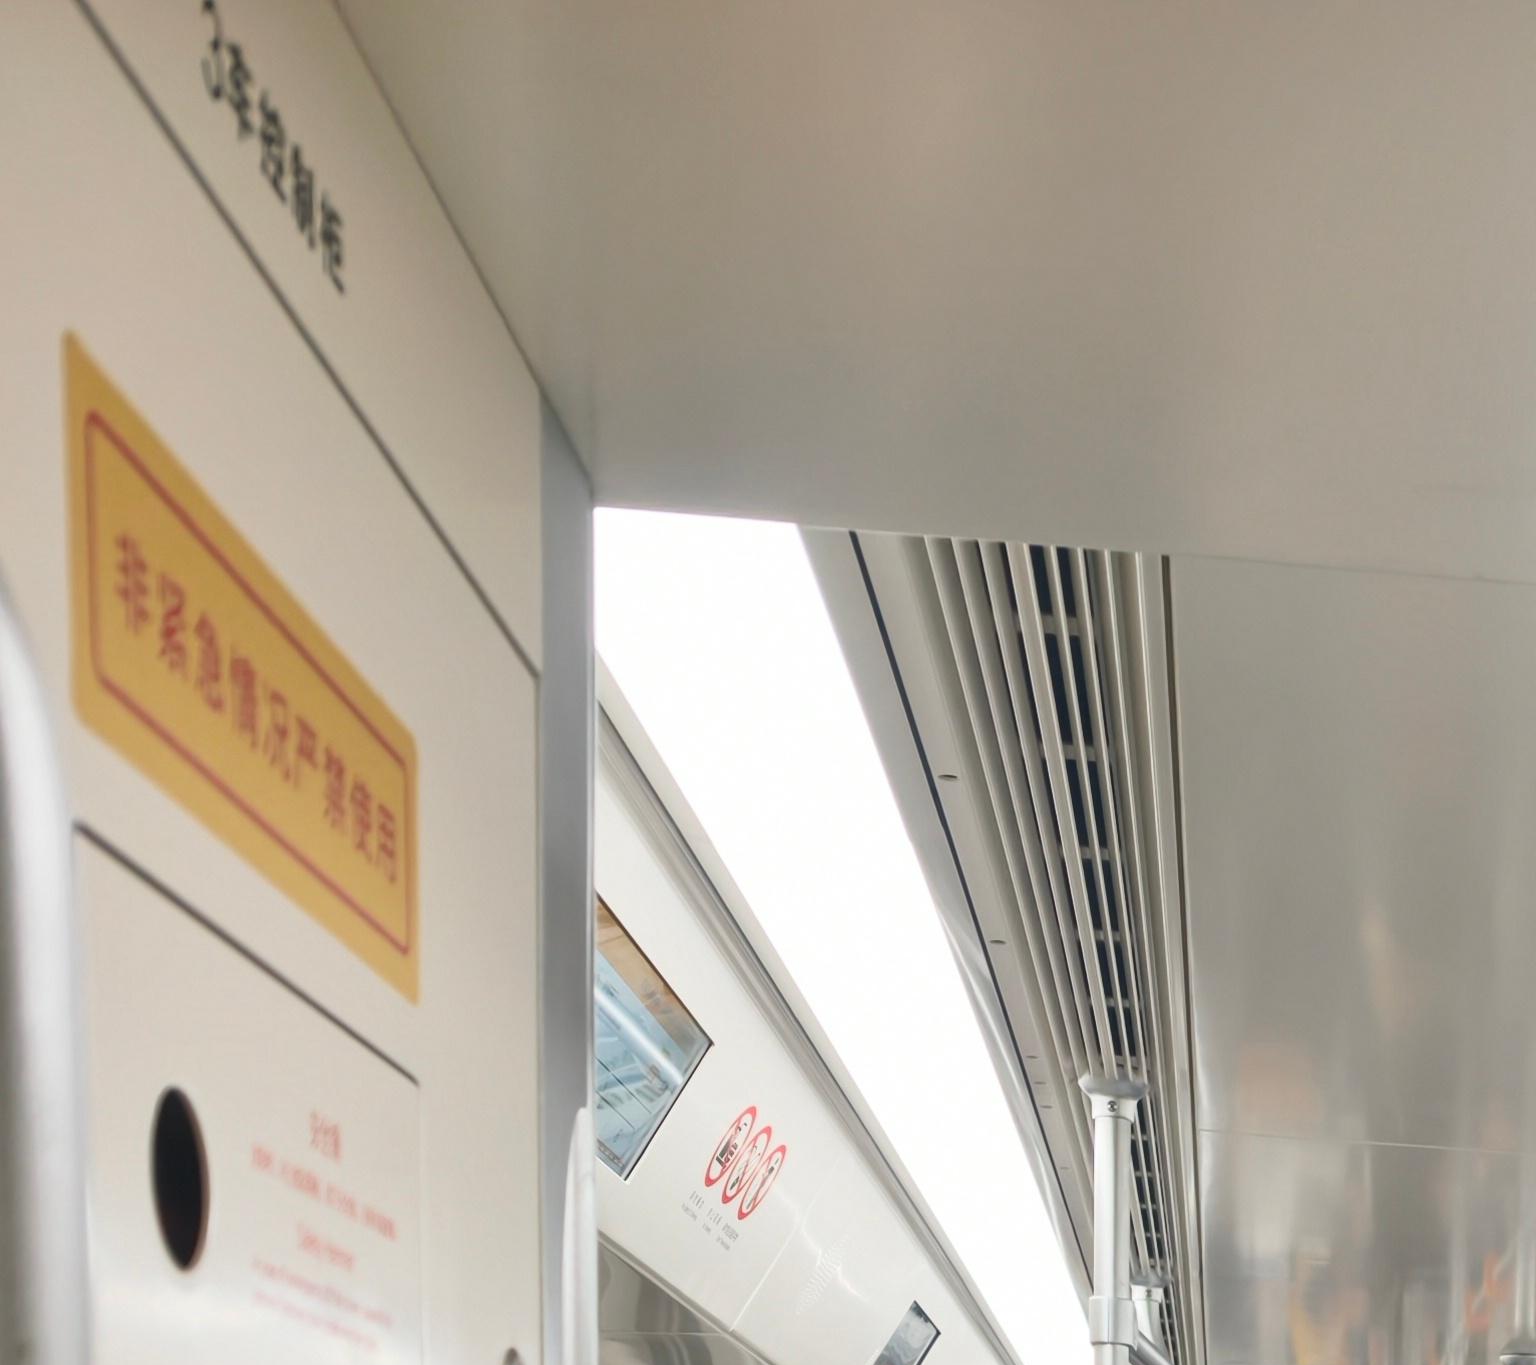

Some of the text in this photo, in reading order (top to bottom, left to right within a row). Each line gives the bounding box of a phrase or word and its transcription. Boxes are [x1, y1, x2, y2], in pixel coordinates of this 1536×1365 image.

[114, 530, 398, 885] 非紧急情况严禁使用
